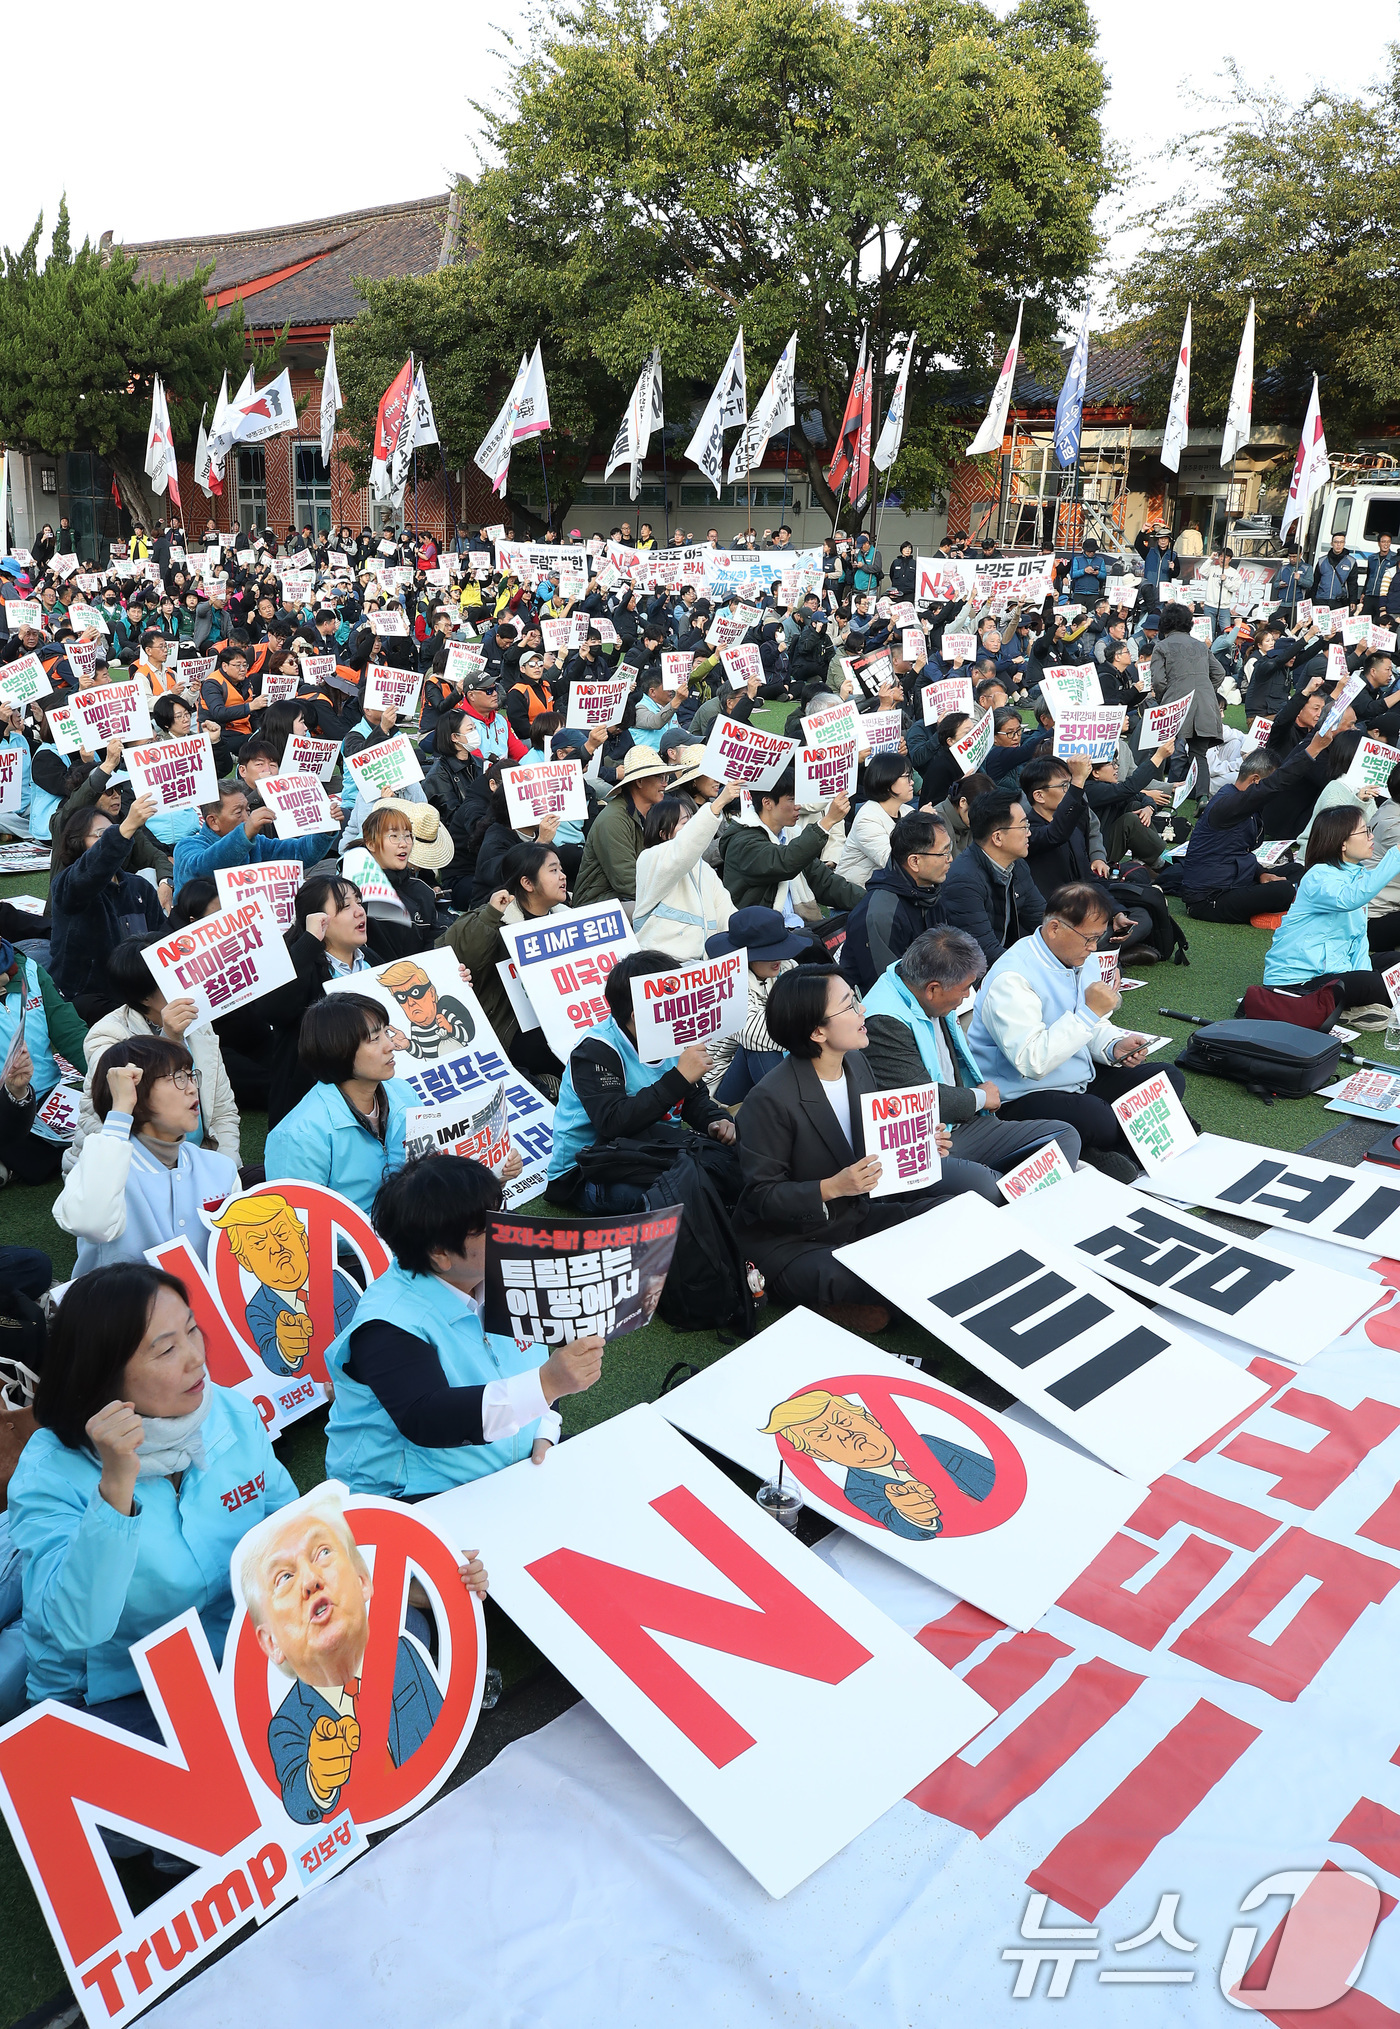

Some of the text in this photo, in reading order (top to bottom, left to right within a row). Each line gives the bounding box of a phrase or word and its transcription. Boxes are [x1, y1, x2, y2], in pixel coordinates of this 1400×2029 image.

[8, 656, 37, 675] TRUMP!
[391, 672, 420, 684] TRUMP!
[2, 667, 38, 692] 안보위협
[14, 683, 38, 700] 규탄!
[375, 681, 414, 694] 대미투자
[598, 682, 628, 694] TRUMP!
[940, 680, 968, 692] TRUMP!
[95, 684, 139, 701] TRUMP!
[382, 694, 406, 707] 철회!
[579, 691, 622, 708] 대미투자
[929, 690, 965, 707] 대미투자
[83, 697, 136, 725] 대미투자
[587, 707, 613, 723] 철회!
[1061, 711, 1124, 722] 국제깡패 트럼프의
[96, 716, 131, 739] 철회!
[722, 722, 793, 753] NO TRUMP!
[1060, 722, 1120, 741] 경제약탈
[134, 738, 206, 766] NO TRUMP!
[293, 751, 332, 762] 대미투자
[310, 741, 339, 752] TRUMP!
[370, 737, 406, 761] TRUMP!
[719, 740, 781, 766] 대미투자
[804, 748, 827, 762] NO
[827, 739, 856, 755] TRUMP!
[144, 754, 203, 785] 대미투자
[361, 754, 405, 780] 안보위협
[373, 767, 404, 790] 규탄!
[511, 764, 576, 783] NO TRUMP!
[724, 760, 764, 782] 철회!
[808, 755, 853, 780] 대미투자
[162, 776, 196, 805] 철회!
[289, 776, 318, 790] TRUMP!
[518, 777, 573, 801] 대미투자
[819, 774, 849, 796] 철회!
[276, 784, 324, 808] 대미투자
[531, 795, 565, 817] 철회!
[293, 804, 322, 826] 철회!
[227, 870, 258, 886] NO
[157, 901, 264, 968] NO TRUMP!
[523, 915, 620, 958] 또 IMF 온다!
[175, 924, 264, 990] 대미투자
[204, 957, 259, 1008] 철회!
[644, 956, 741, 1000] NO TRUMP!
[654, 977, 734, 1023] 대미투자
[673, 1006, 721, 1046] 철회!
[872, 1089, 936, 1121] NO TRUMP!
[1118, 1078, 1168, 1122] NO TRUMP!
[437, 1118, 470, 1145] IMF
[880, 1111, 933, 1151] 대미투자
[1129, 1099, 1171, 1144] 안보위협
[1146, 1127, 1175, 1160] 규탄!
[897, 1141, 932, 1178] 철회!
[1004, 1148, 1061, 1199] NO TRUMP!
[500, 1246, 632, 1288] 트럼프는
[506, 1268, 640, 1318] 이 땅에서
[510, 1308, 616, 1345] 나가라!
[278, 1380, 316, 1409] 진보당
[220, 1471, 266, 1513] 진보당
[300, 1818, 354, 1874] 진보당
[81, 1842, 288, 2018] Trump
